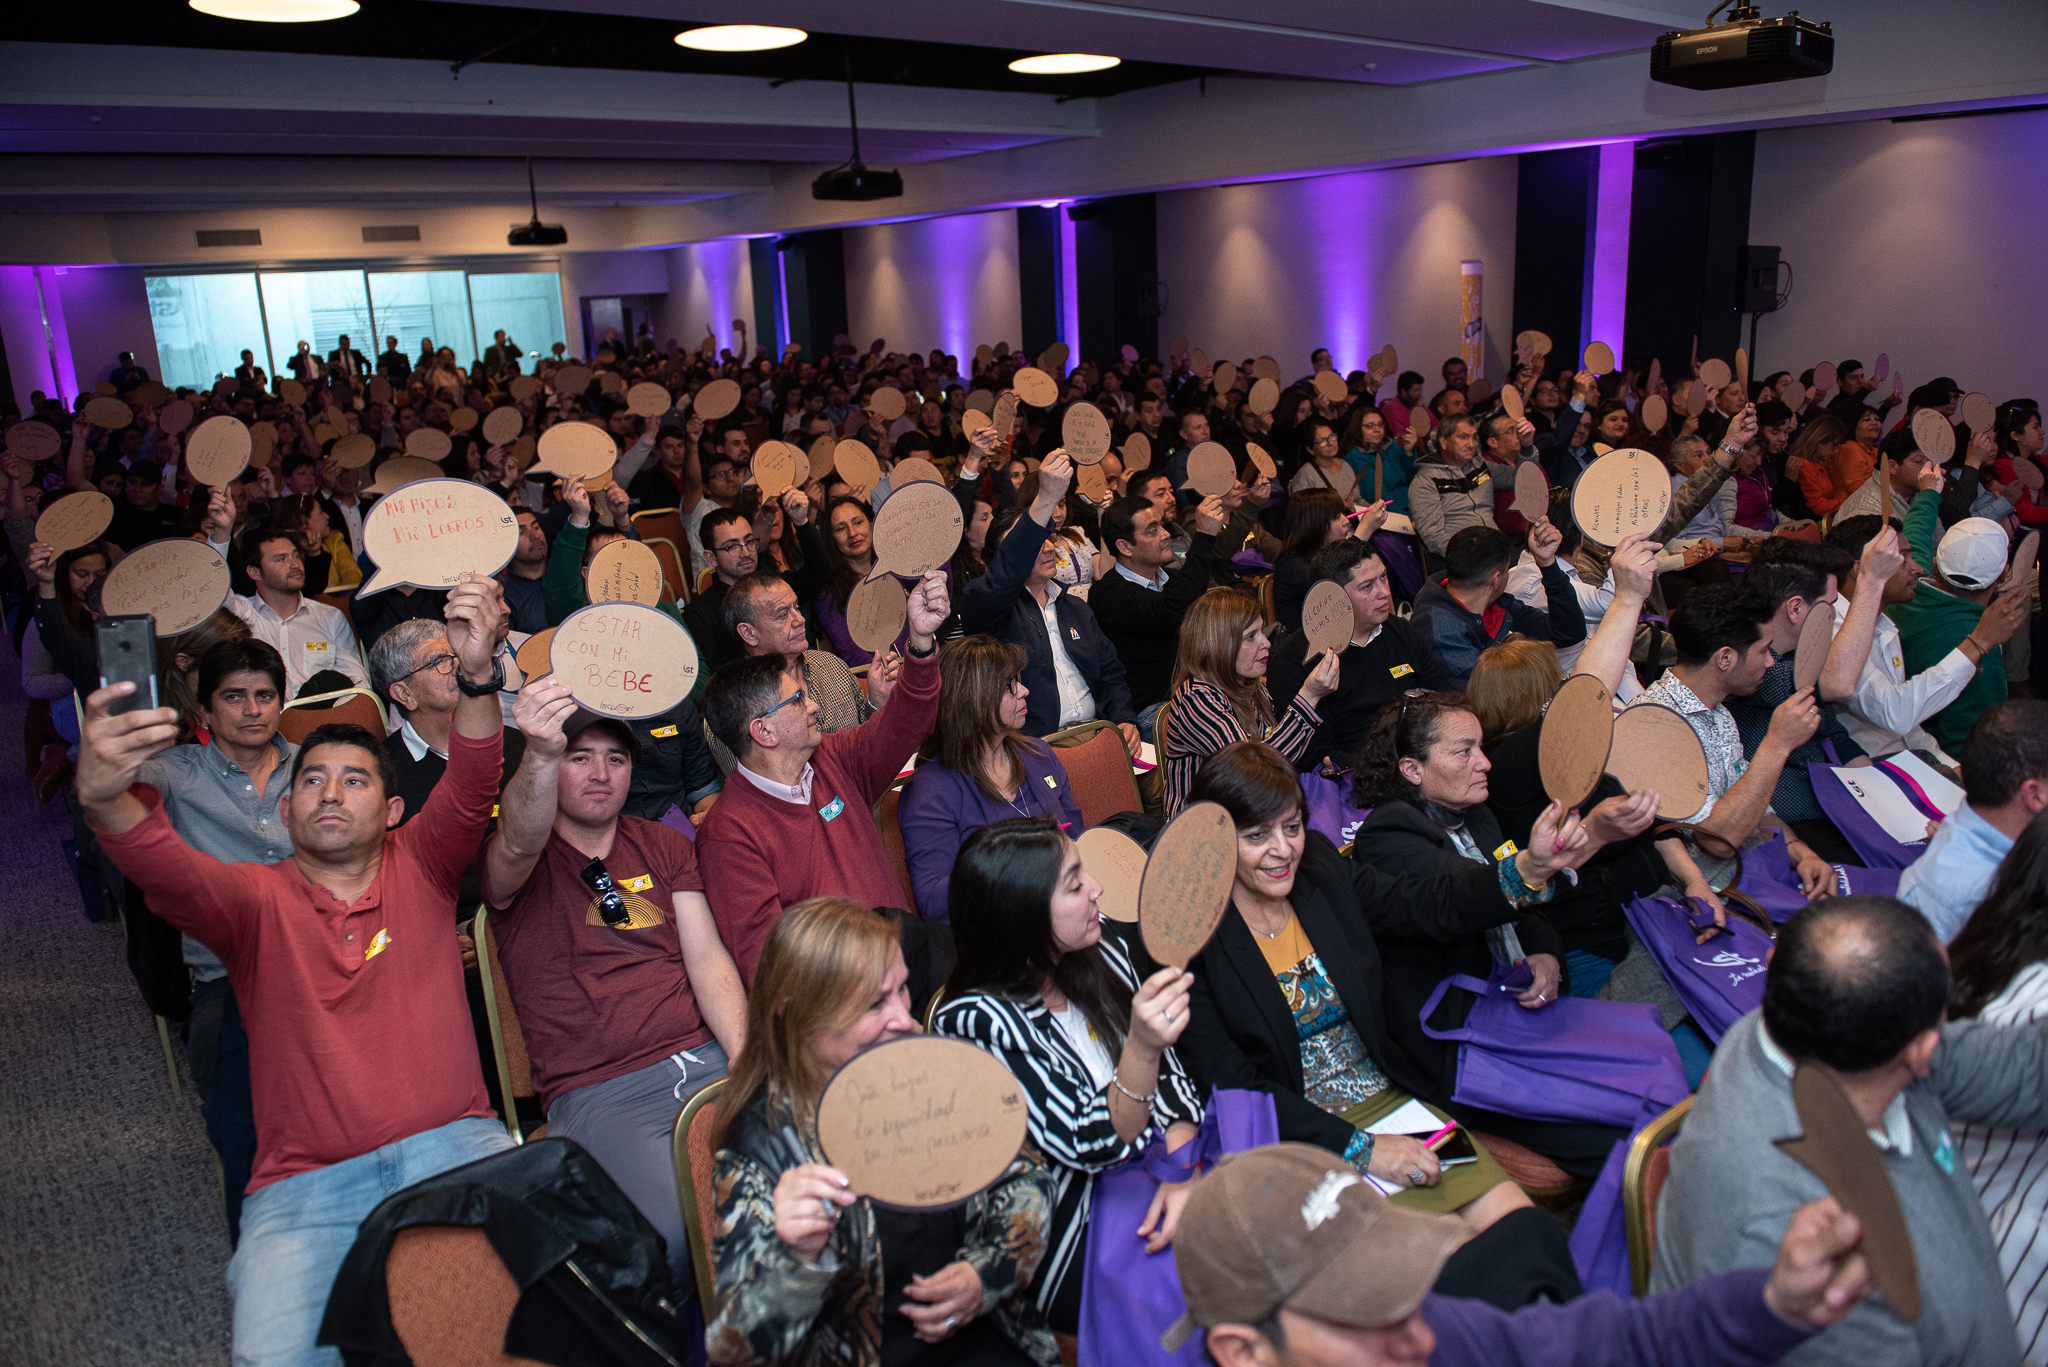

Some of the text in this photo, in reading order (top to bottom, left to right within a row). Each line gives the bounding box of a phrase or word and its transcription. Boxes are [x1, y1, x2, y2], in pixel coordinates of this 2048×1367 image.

[1696, 46, 1718, 55] EPSON
[500, 515, 514, 524] ist
[181, 580, 213, 604] hijos
[1304, 610, 1313, 626] EL
[578, 612, 642, 641] ESTAR
[566, 640, 599, 657] CON
[682, 664, 695, 675] ist
[584, 663, 653, 693] BEBE
